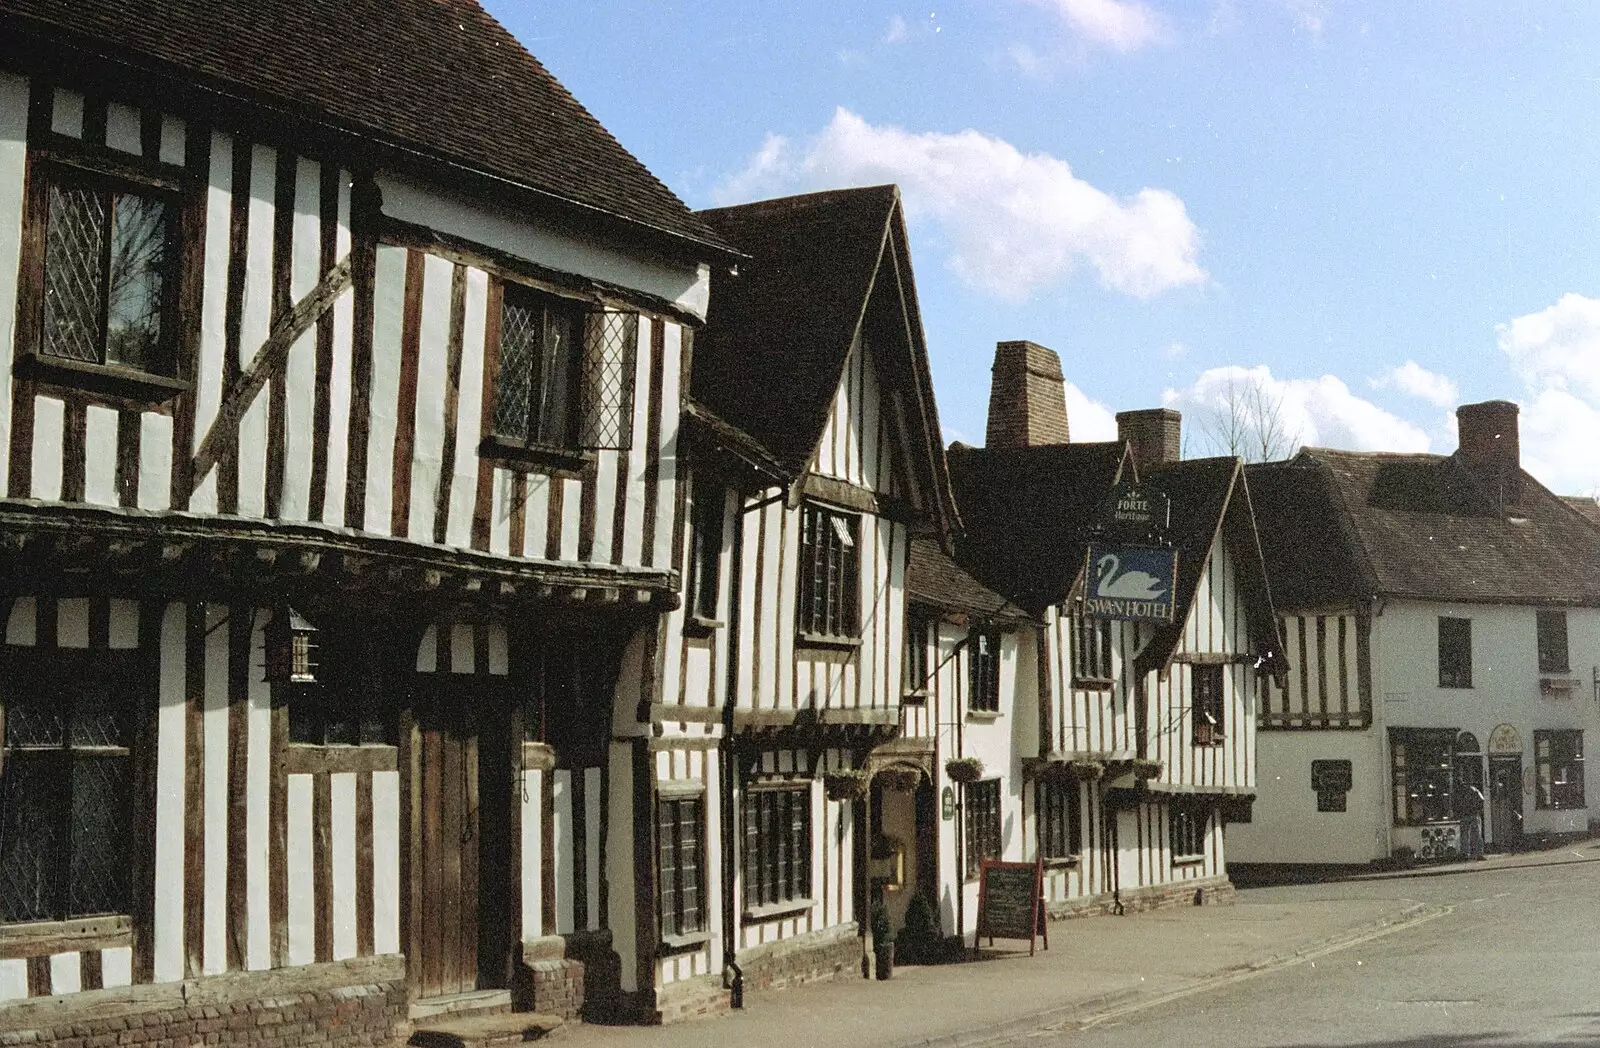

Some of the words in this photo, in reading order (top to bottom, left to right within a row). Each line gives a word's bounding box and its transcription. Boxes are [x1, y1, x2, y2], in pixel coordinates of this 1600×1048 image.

[1117, 500, 1148, 511] FORTE
[1086, 598, 1125, 615] SWAN
[1126, 600, 1169, 618] HOTEL
